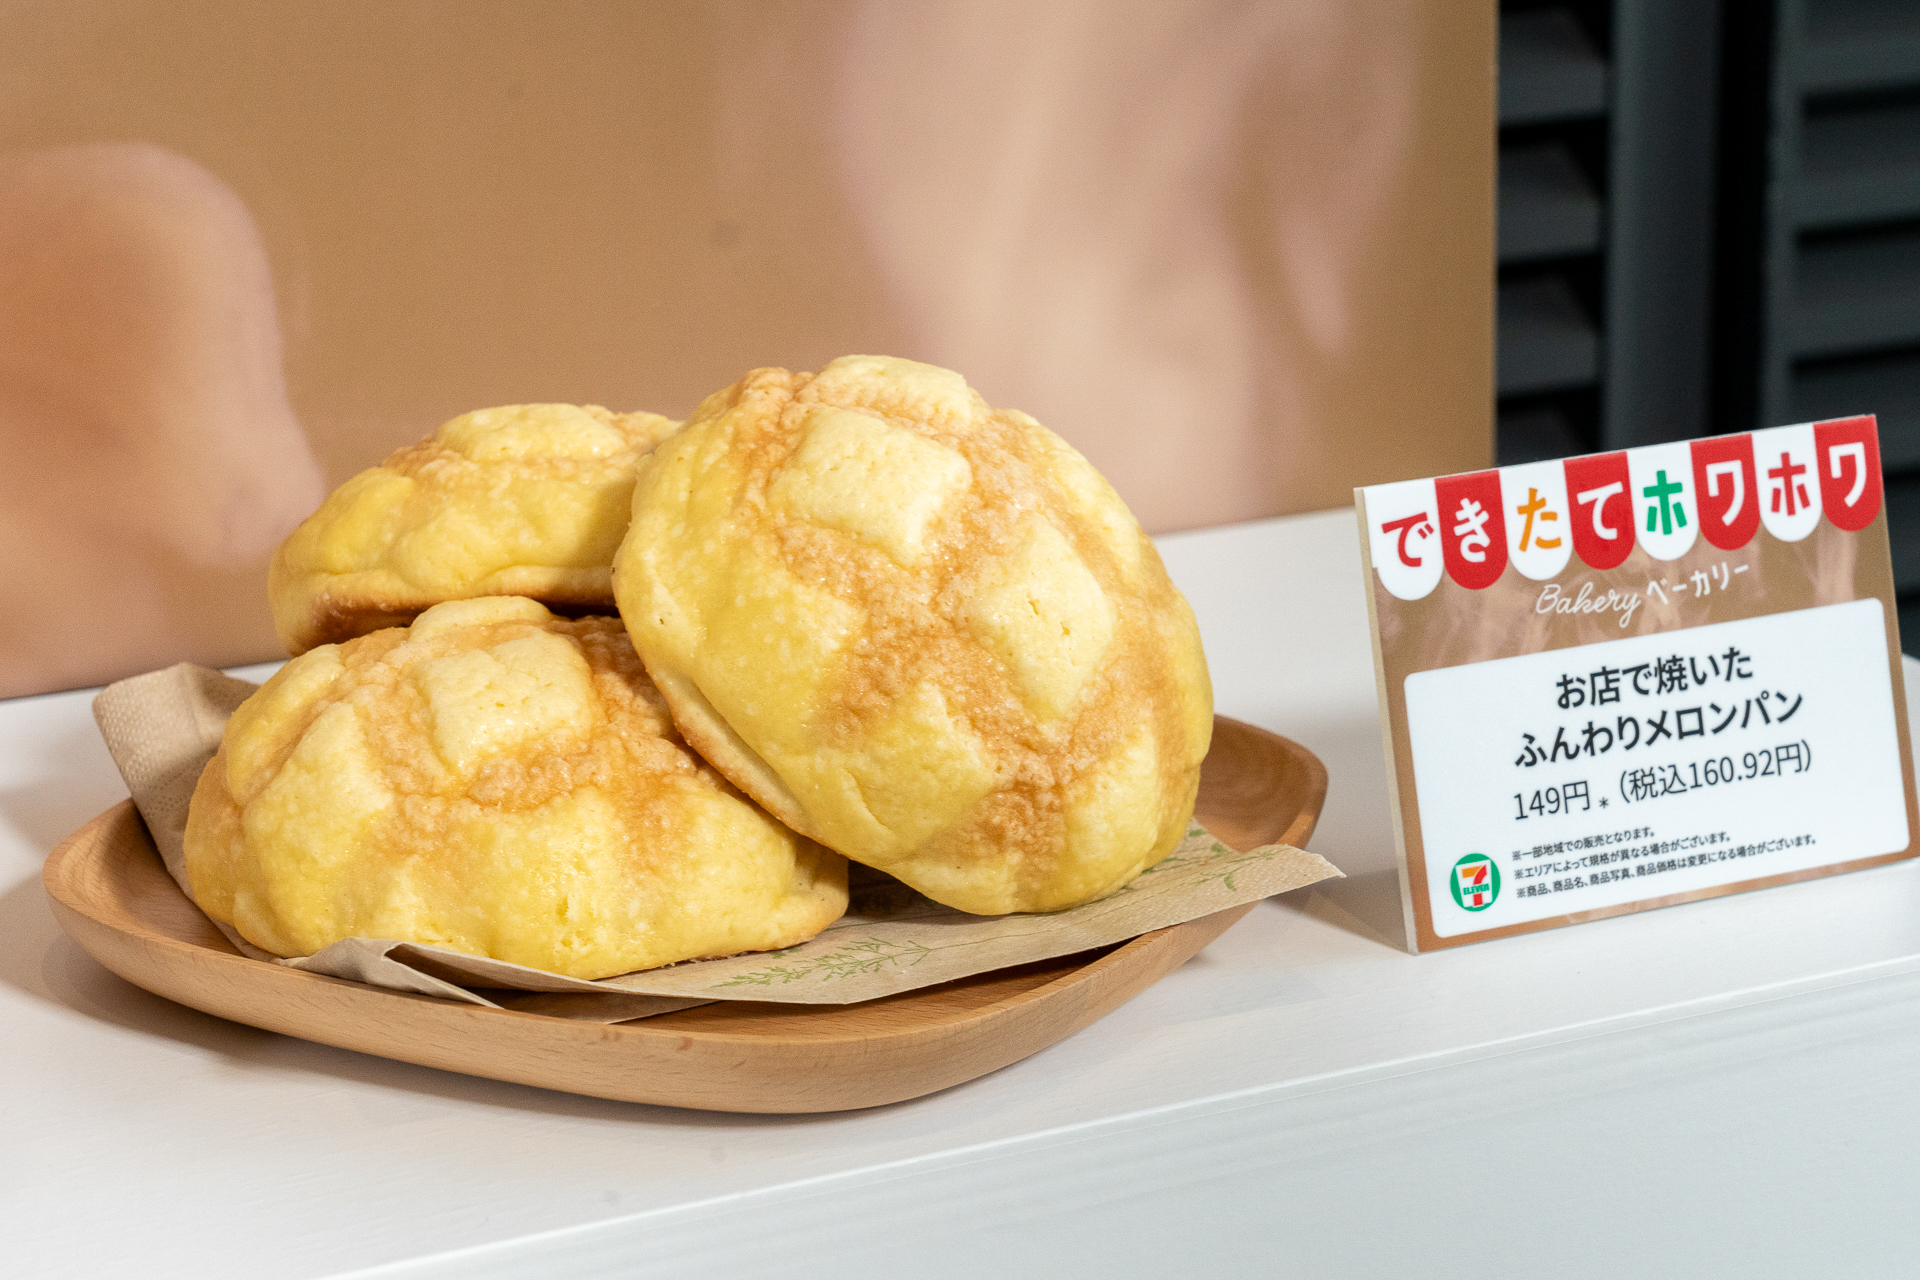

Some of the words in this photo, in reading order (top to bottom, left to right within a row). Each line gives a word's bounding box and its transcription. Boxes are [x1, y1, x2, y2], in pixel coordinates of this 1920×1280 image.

[1381, 441, 1867, 569] できたてホワホワ
[1535, 582, 1642, 628] Bakery
[1645, 561, 1750, 606] ベーカリー
[1555, 646, 1754, 710] お店で焼いた
[1514, 690, 1804, 768] ふんわりメロンパン
[1513, 780, 1592, 820] 149円
[1511, 826, 1655, 862] ※一部地域での販売となります。
